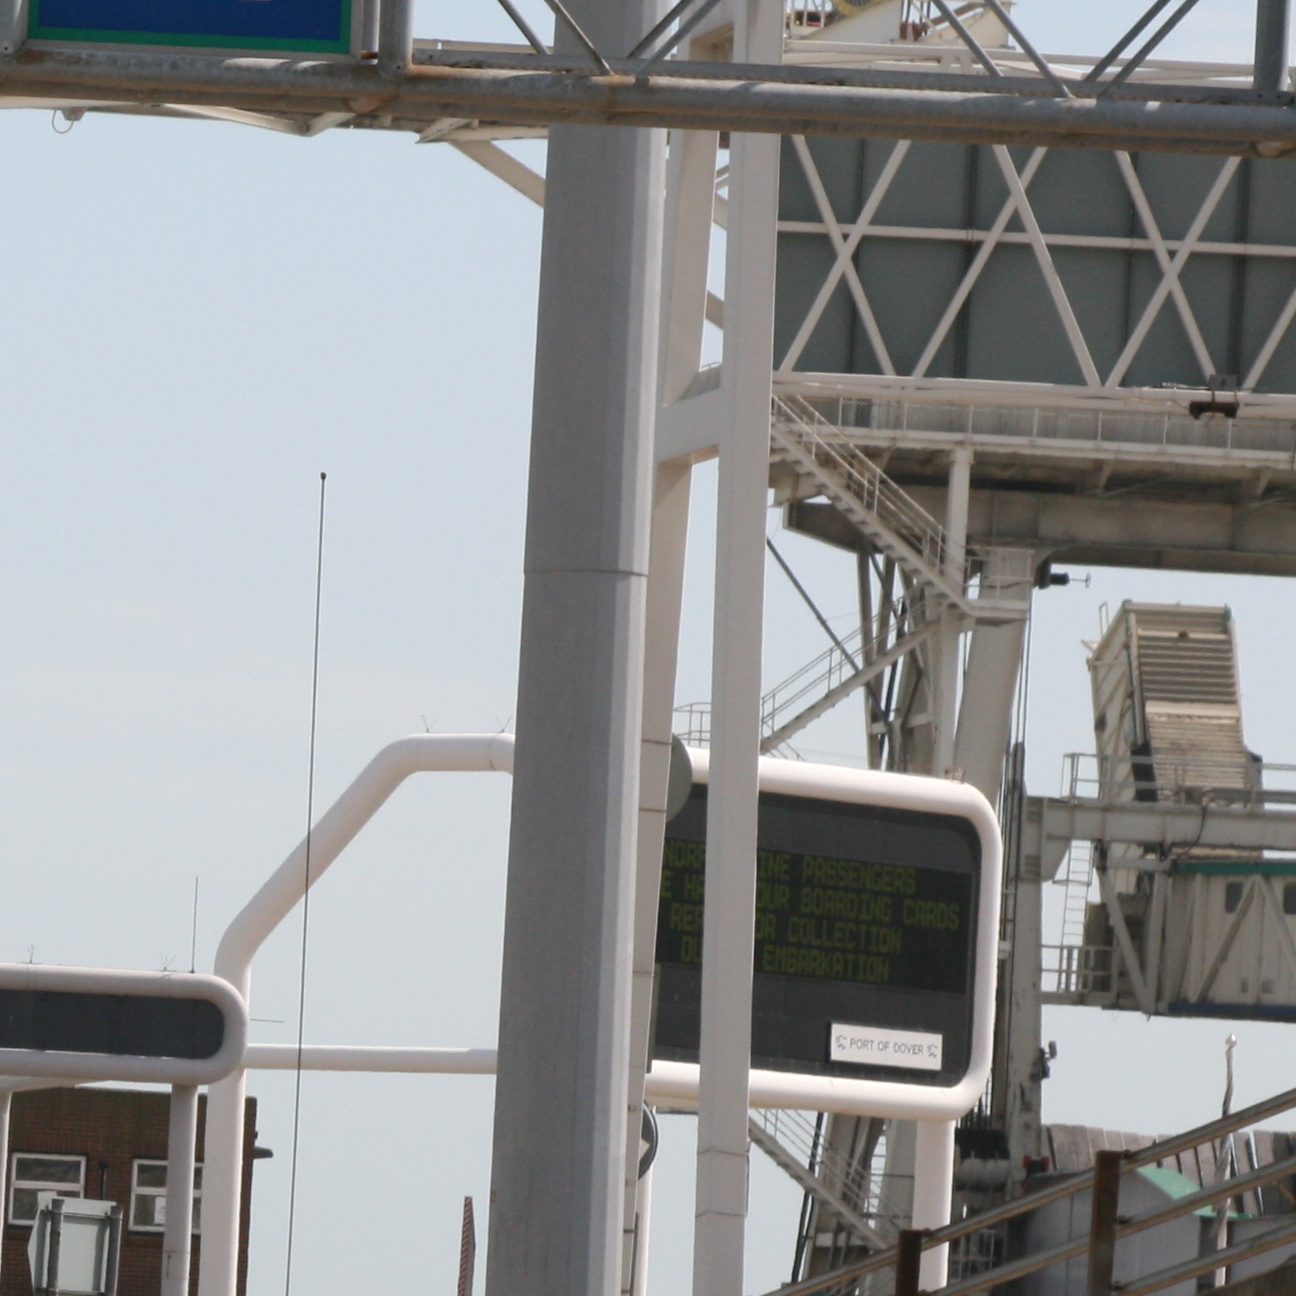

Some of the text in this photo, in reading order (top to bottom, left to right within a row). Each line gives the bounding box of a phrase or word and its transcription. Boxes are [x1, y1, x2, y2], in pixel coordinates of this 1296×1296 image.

[802, 856, 917, 895] PASSENGERS
[800, 887, 893, 923] BOARDING
[903, 899, 960, 930] CARDS
[787, 916, 903, 954] COLLECTION
[762, 944, 890, 983] EMBARKATION
[849, 1038, 924, 1055] PORT OF DOVER
